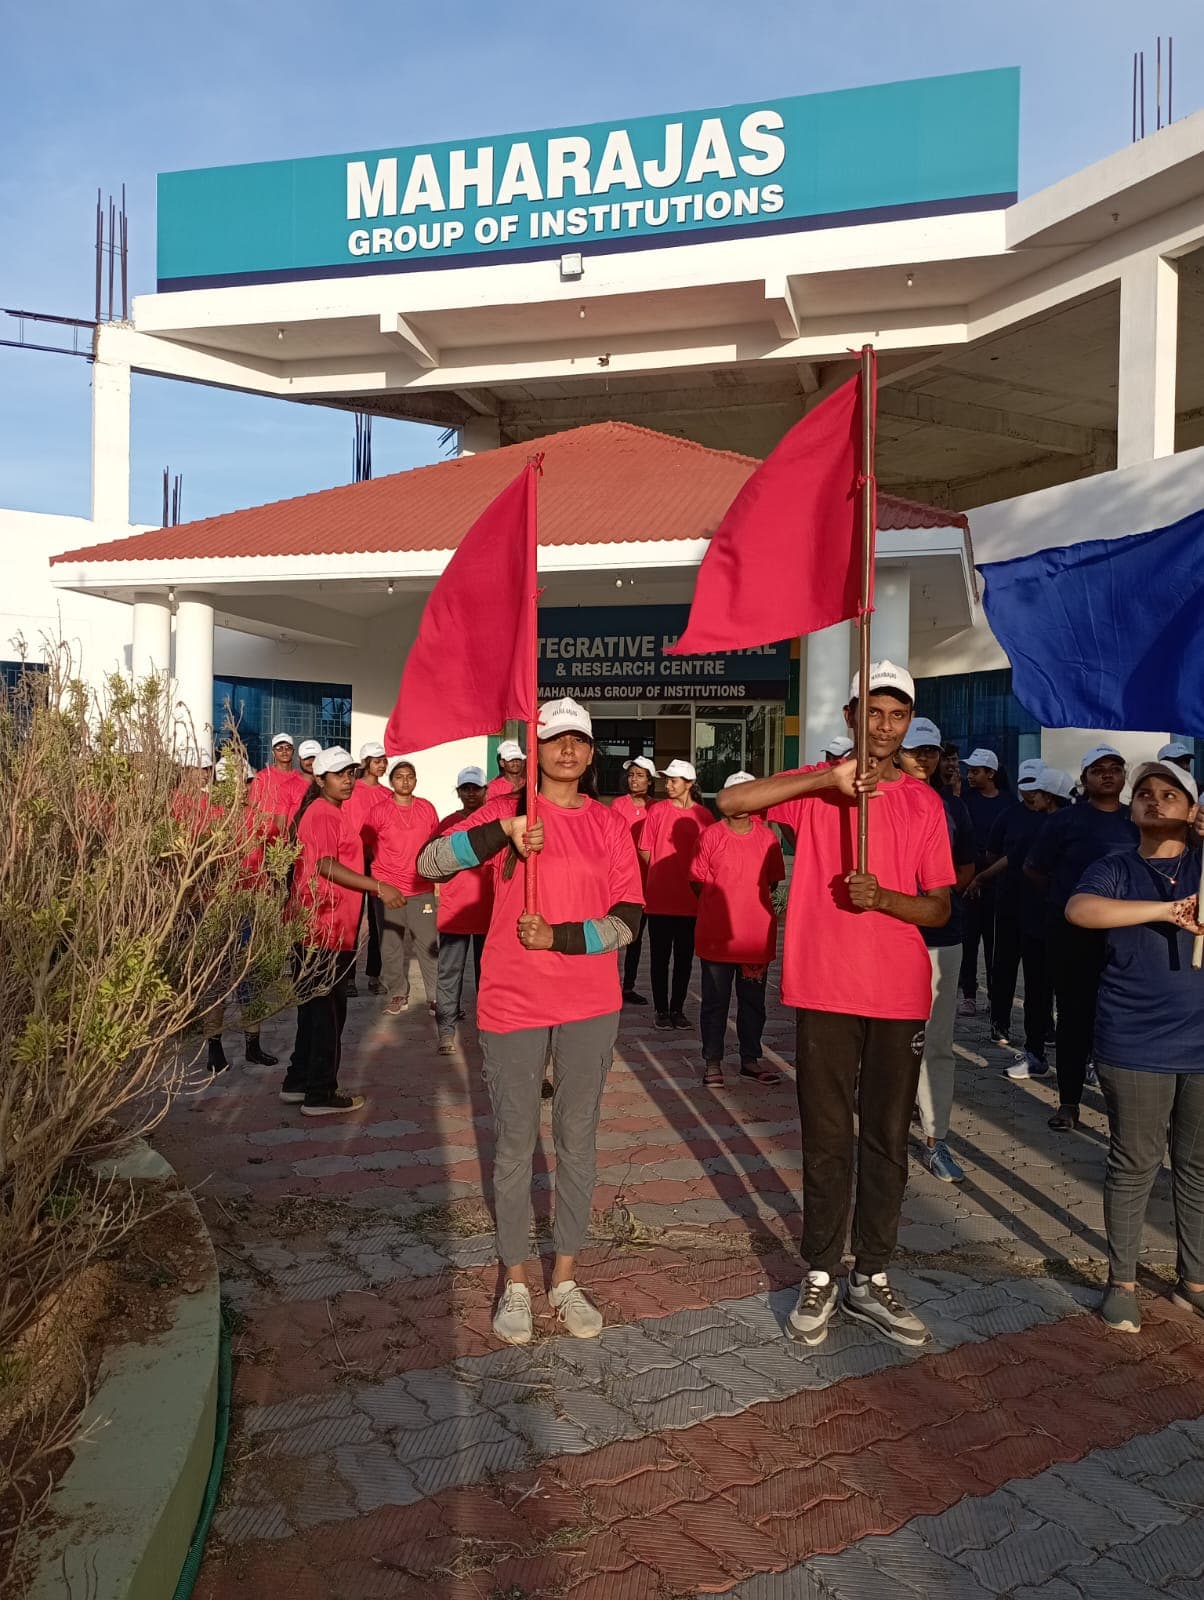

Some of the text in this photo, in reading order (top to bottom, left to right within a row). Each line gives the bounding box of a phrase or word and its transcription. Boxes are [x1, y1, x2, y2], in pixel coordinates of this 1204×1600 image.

[346, 109, 786, 221] MAHARAJAS
[347, 183, 785, 257] GROUP OF INSTITUTIONS
[536, 635, 656, 659] TEGRATIVE
[555, 659, 726, 677] & RESEARCH CENTRE
[537, 684, 746, 698] MAHARAJAS GROUP OF INSTITUTIONS
